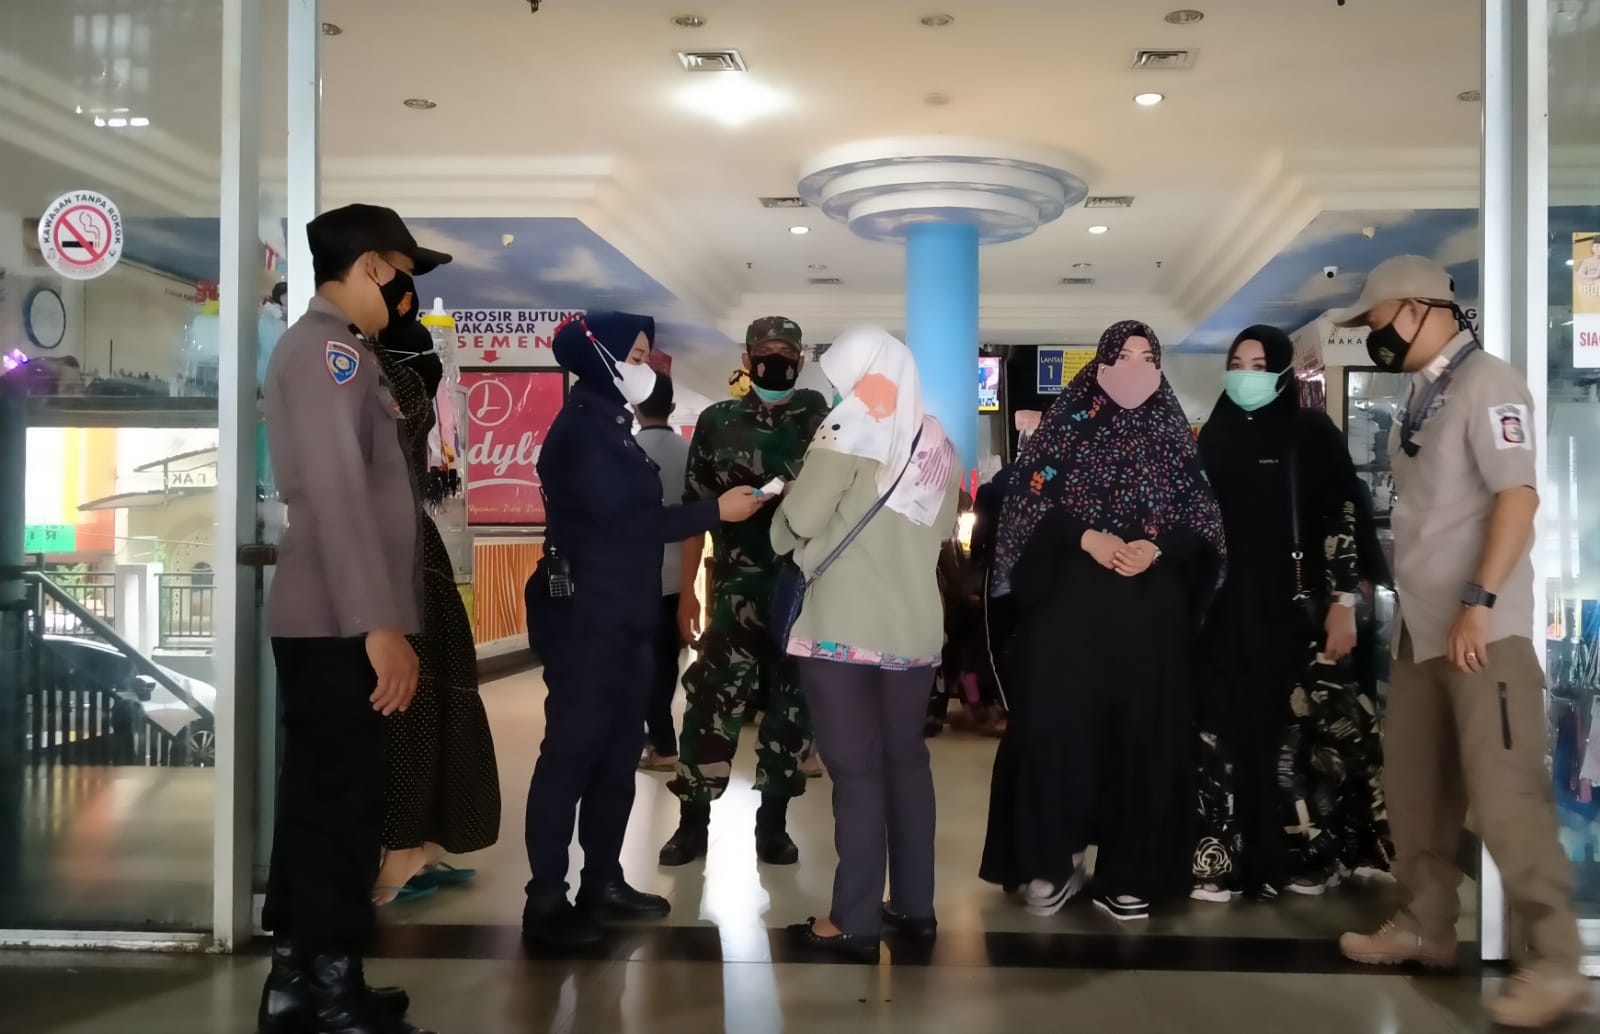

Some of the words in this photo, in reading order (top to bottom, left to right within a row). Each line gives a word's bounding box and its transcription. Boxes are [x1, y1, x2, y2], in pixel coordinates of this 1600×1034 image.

[43, 198, 72, 244] KAWASAN
[75, 194, 107, 208] TANPA
[107, 207, 121, 244] ROKOK
[452, 311, 512, 322] GROSIR
[518, 311, 585, 322] BUTUN
[457, 336, 552, 349] SEMEN
[1580, 331, 1600, 347] SIA
[1047, 365, 1053, 380] 1
